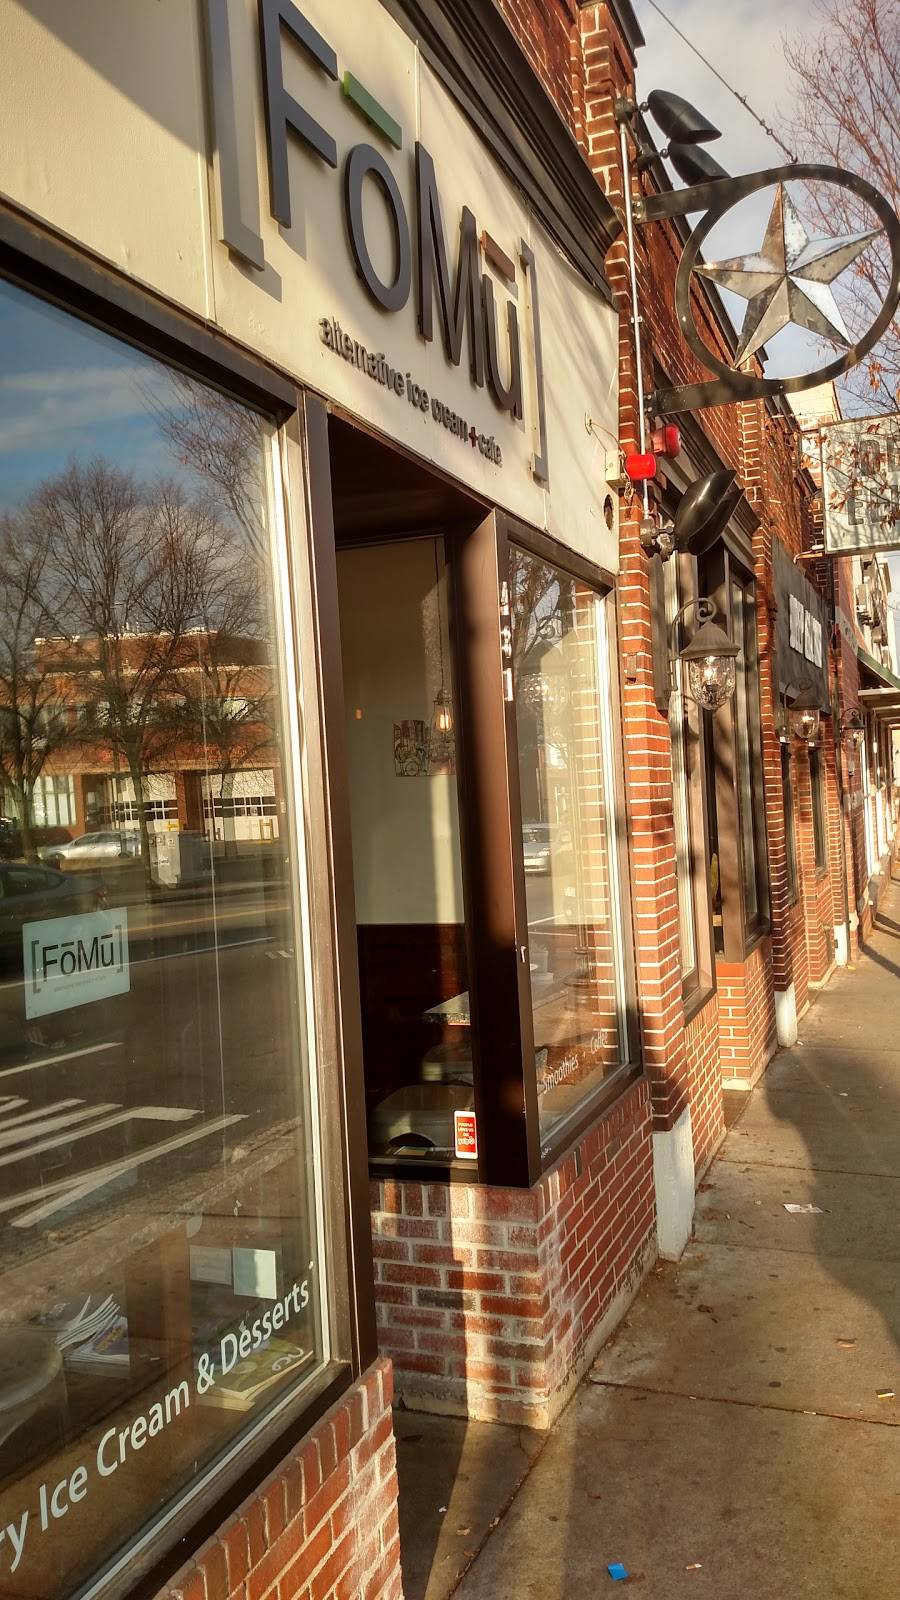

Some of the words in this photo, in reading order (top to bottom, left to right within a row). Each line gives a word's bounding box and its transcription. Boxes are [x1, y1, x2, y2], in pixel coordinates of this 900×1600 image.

[319, 315, 405, 397] alternative
[405, 372, 430, 413] ice
[431, 397, 469, 443] cream
[542, 1054, 579, 1094] Smoothies
[39, 1465, 88, 1532] Ice
[97, 1381, 190, 1476] Cream
[197, 1353, 215, 1395] &
[221, 1279, 309, 1376] Desserts
